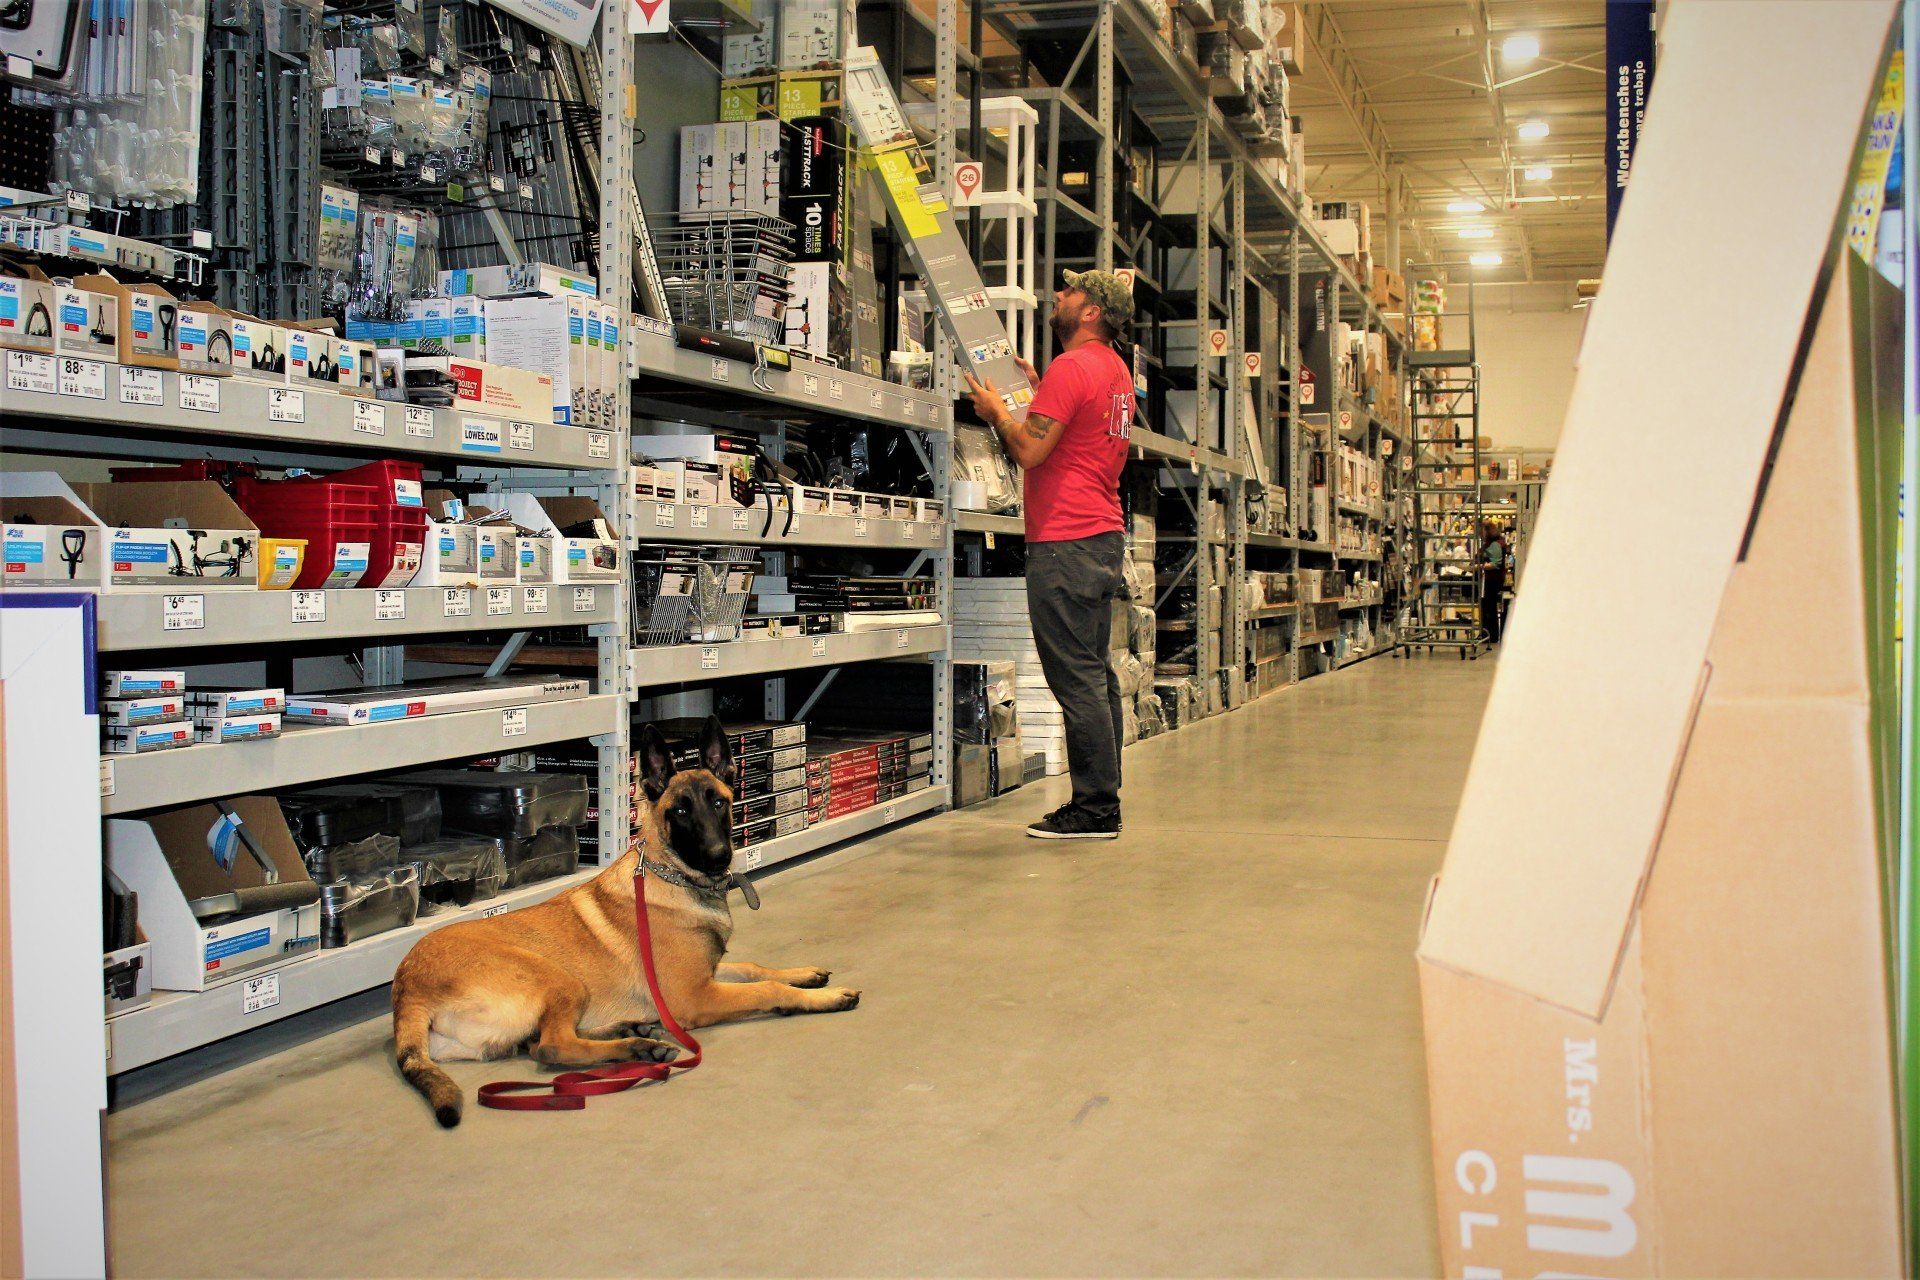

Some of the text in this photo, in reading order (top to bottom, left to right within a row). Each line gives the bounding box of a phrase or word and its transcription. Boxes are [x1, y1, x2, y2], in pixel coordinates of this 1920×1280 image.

[1633, 60, 1646, 106] trabajo
[784, 89, 801, 102] 13
[724, 96, 740, 109] 13
[724, 109, 744, 117] PIECE
[784, 109, 817, 117] STARTER
[1617, 65, 1630, 187] Workbenches
[803, 126, 812, 188] FASTTRACK
[881, 160, 898, 172] 13
[961, 174, 975, 182] 26
[805, 202, 823, 253] 10 TIMES
[804, 226, 812, 254] space
[1315, 288, 1325, 332] GLADIATOR
[457, 379, 478, 390] ROJECT
[457, 388, 476, 397] OURCE
[464, 430, 499, 442] LOWES.COM
[1563, 1037, 1598, 1145] Mrs.
